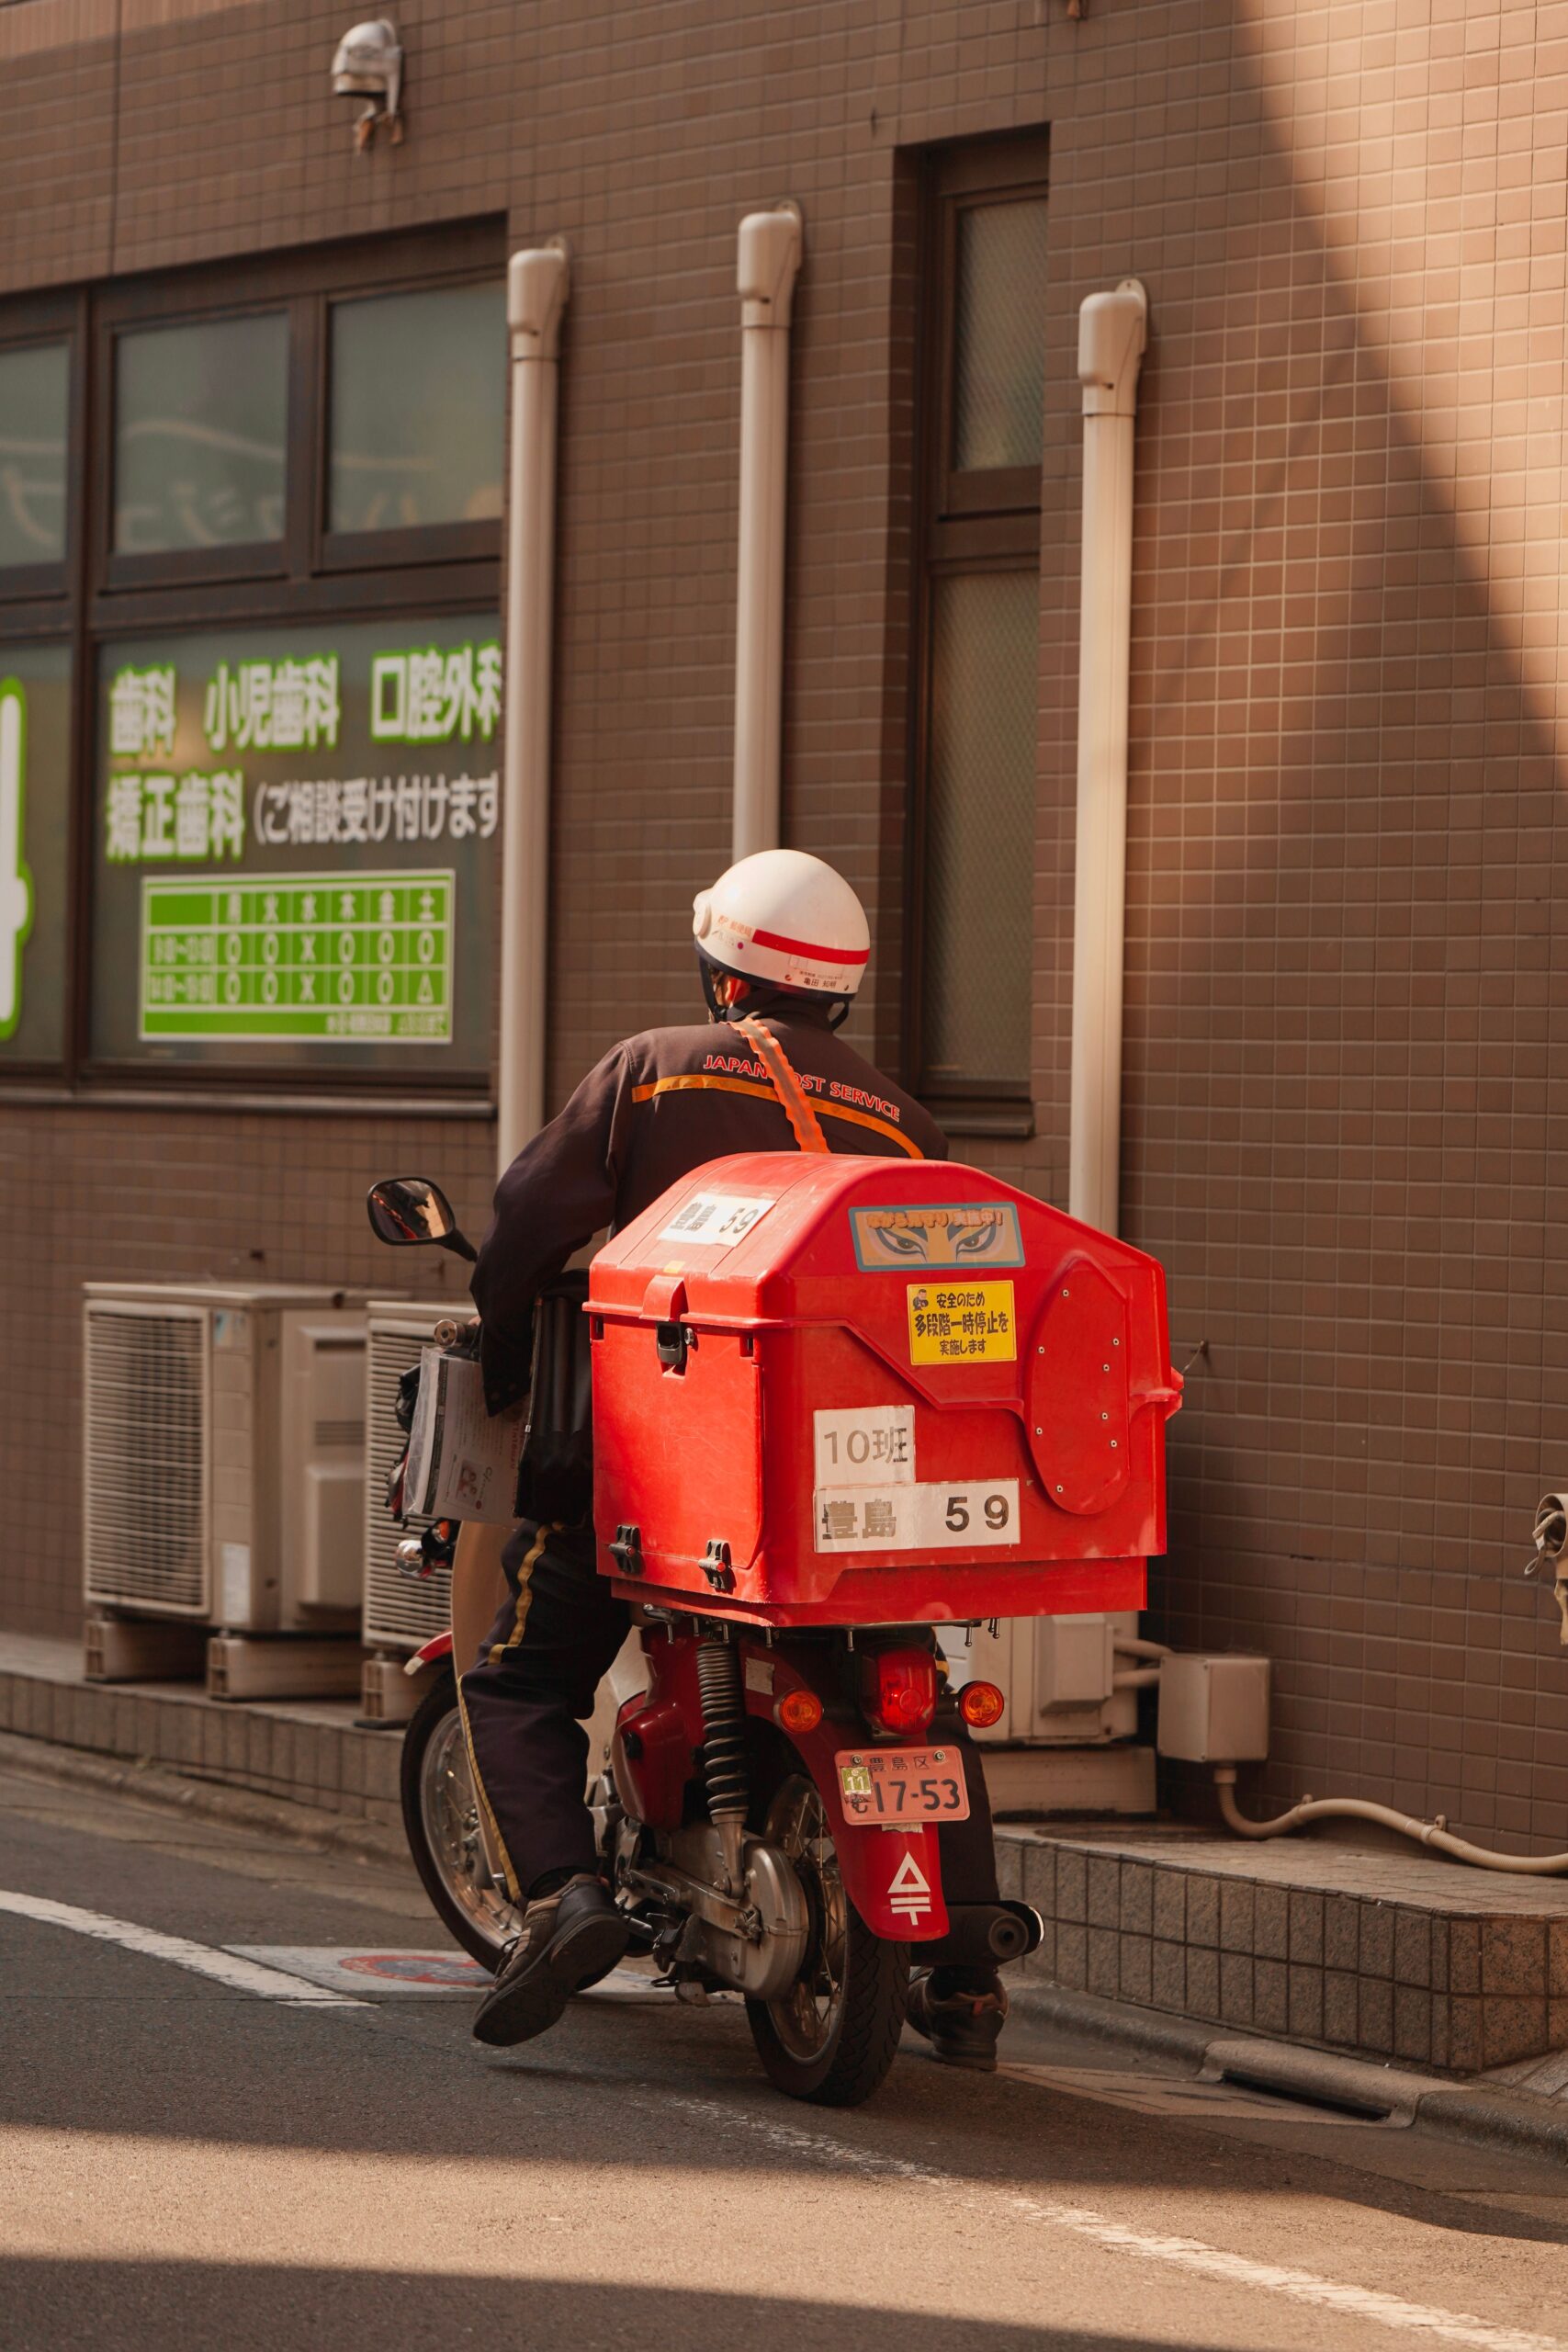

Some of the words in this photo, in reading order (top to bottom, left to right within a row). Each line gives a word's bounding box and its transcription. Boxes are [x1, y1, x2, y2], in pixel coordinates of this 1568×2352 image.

[108, 665, 176, 756] 歯科
[203, 652, 340, 752] 小児歯科
[105, 770, 244, 864] 矯正歯科
[704, 1055, 768, 1080] JAPAN
[793, 1071, 826, 1092] OST
[829, 1081, 900, 1122] SERVICE
[719, 1207, 760, 1234] 59
[936, 1292, 986, 1309] 安全のため
[915, 1311, 1009, 1338] 多段階一時停止を
[940, 1339, 987, 1356] 実施します
[823, 1426, 908, 1464] 10班
[869, 1756, 930, 1771] 豊島区
[847, 1776, 865, 1791] 11
[874, 1779, 960, 1813] 17-53
